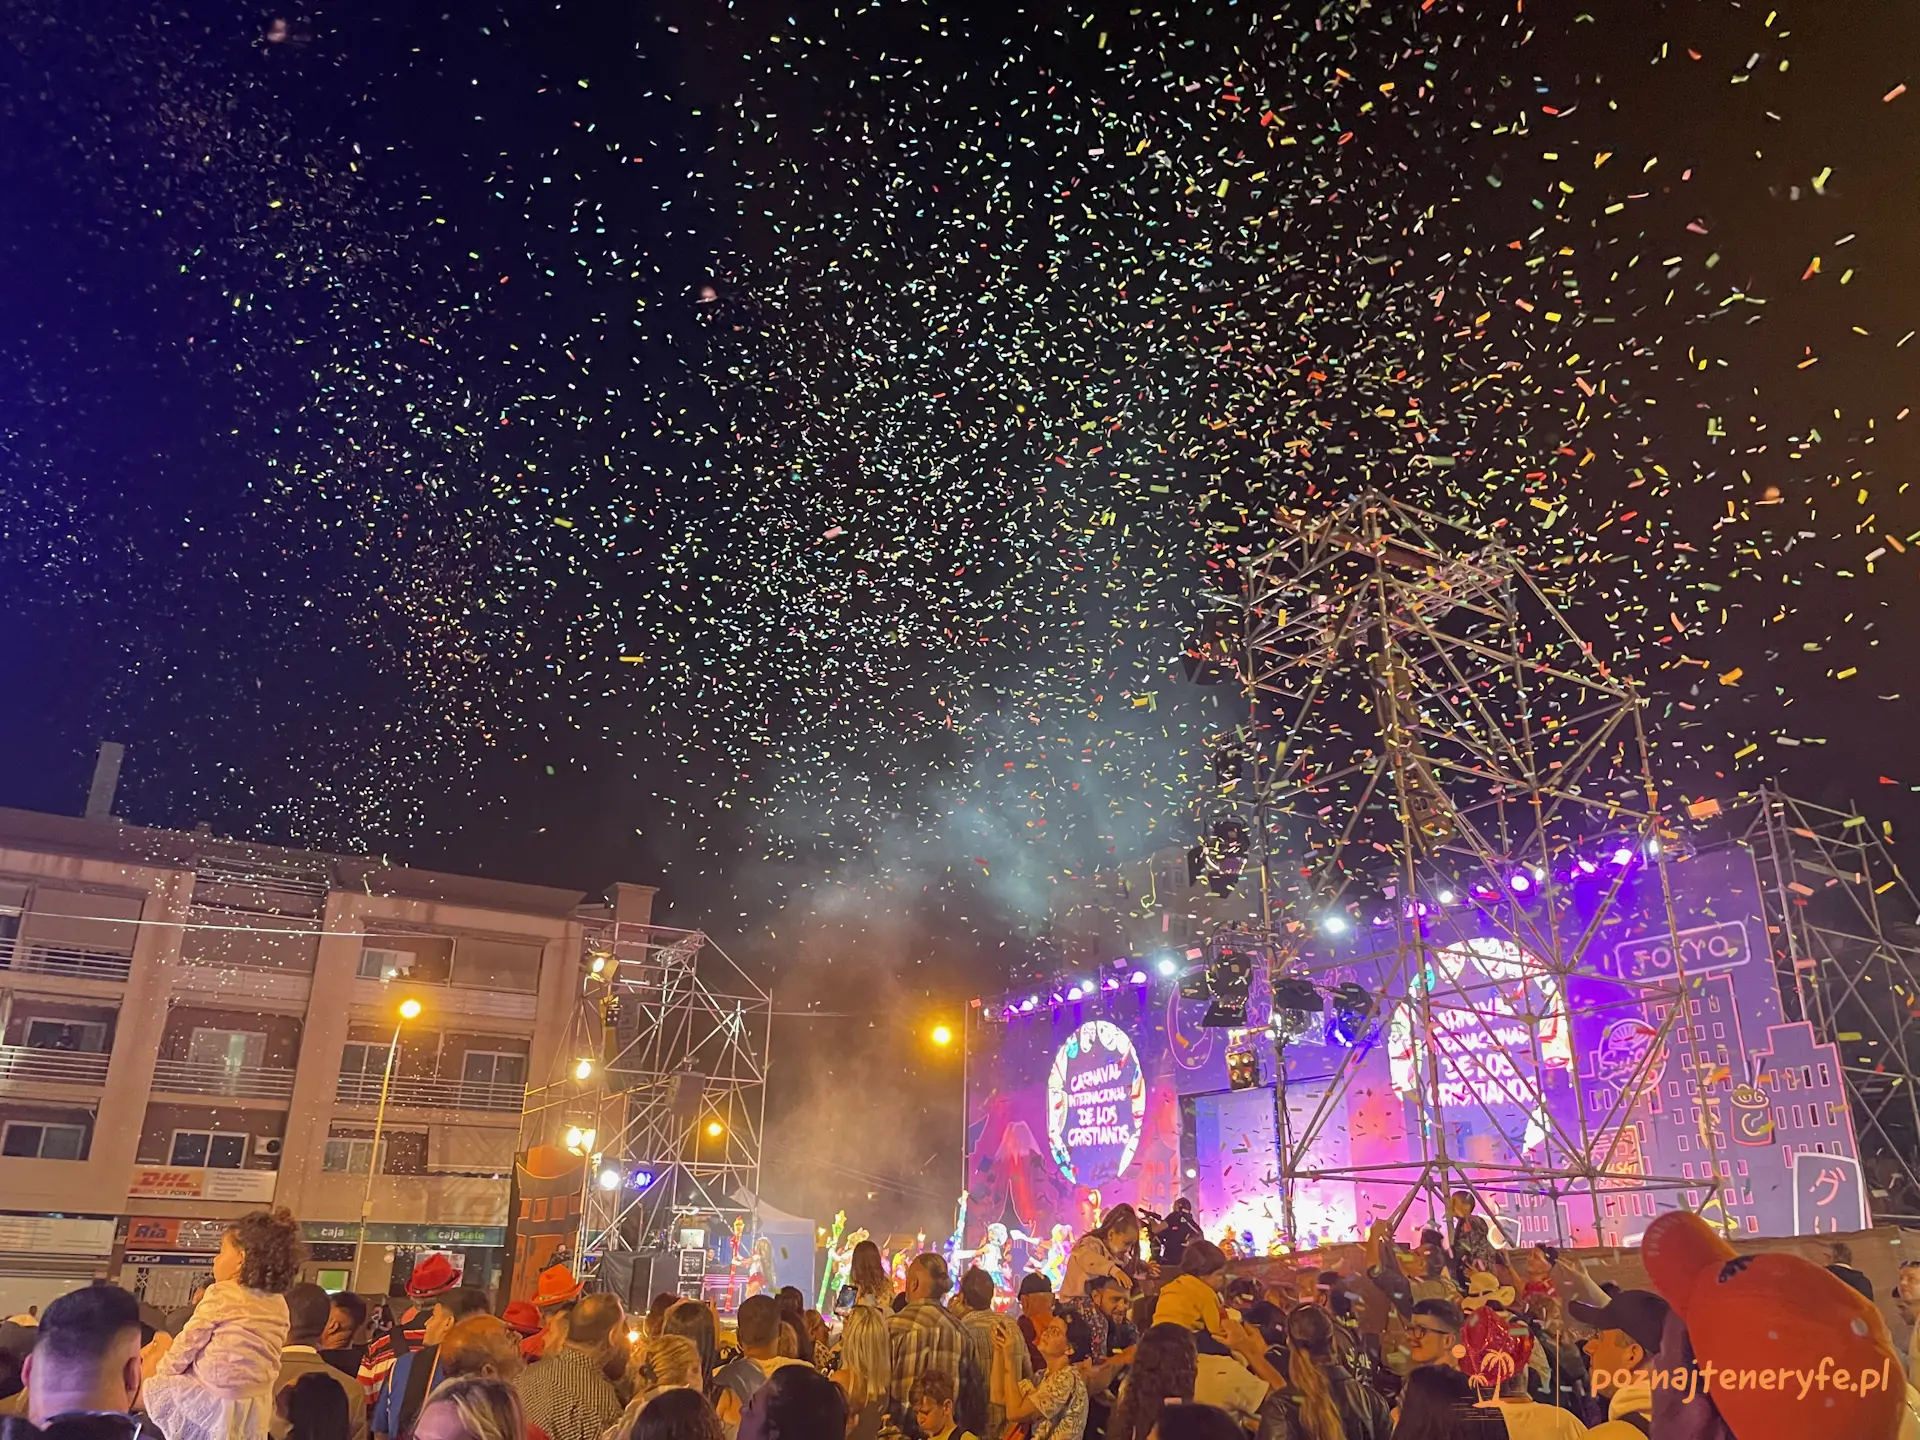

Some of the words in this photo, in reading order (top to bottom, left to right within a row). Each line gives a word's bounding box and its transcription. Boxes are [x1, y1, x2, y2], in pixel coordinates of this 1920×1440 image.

[1423, 1025, 1529, 1056] ITERNACIONAL
[1441, 1055, 1475, 1080] DE
[1476, 1051, 1515, 1078] LOS
[1071, 1063, 1121, 1092] CARNAVAL
[1068, 1086, 1126, 1107] INTERNACIONAL
[1077, 1107, 1095, 1126] DE
[1097, 1105, 1117, 1125] LOS
[1068, 1124, 1129, 1147] CRISTIANOS
[139, 1172, 191, 1187] DHL
[169, 1188, 194, 1196] POINT
[135, 1222, 167, 1238] Ria
[438, 1230, 484, 1241] cajasiete
[127, 1255, 160, 1263] DIGI
